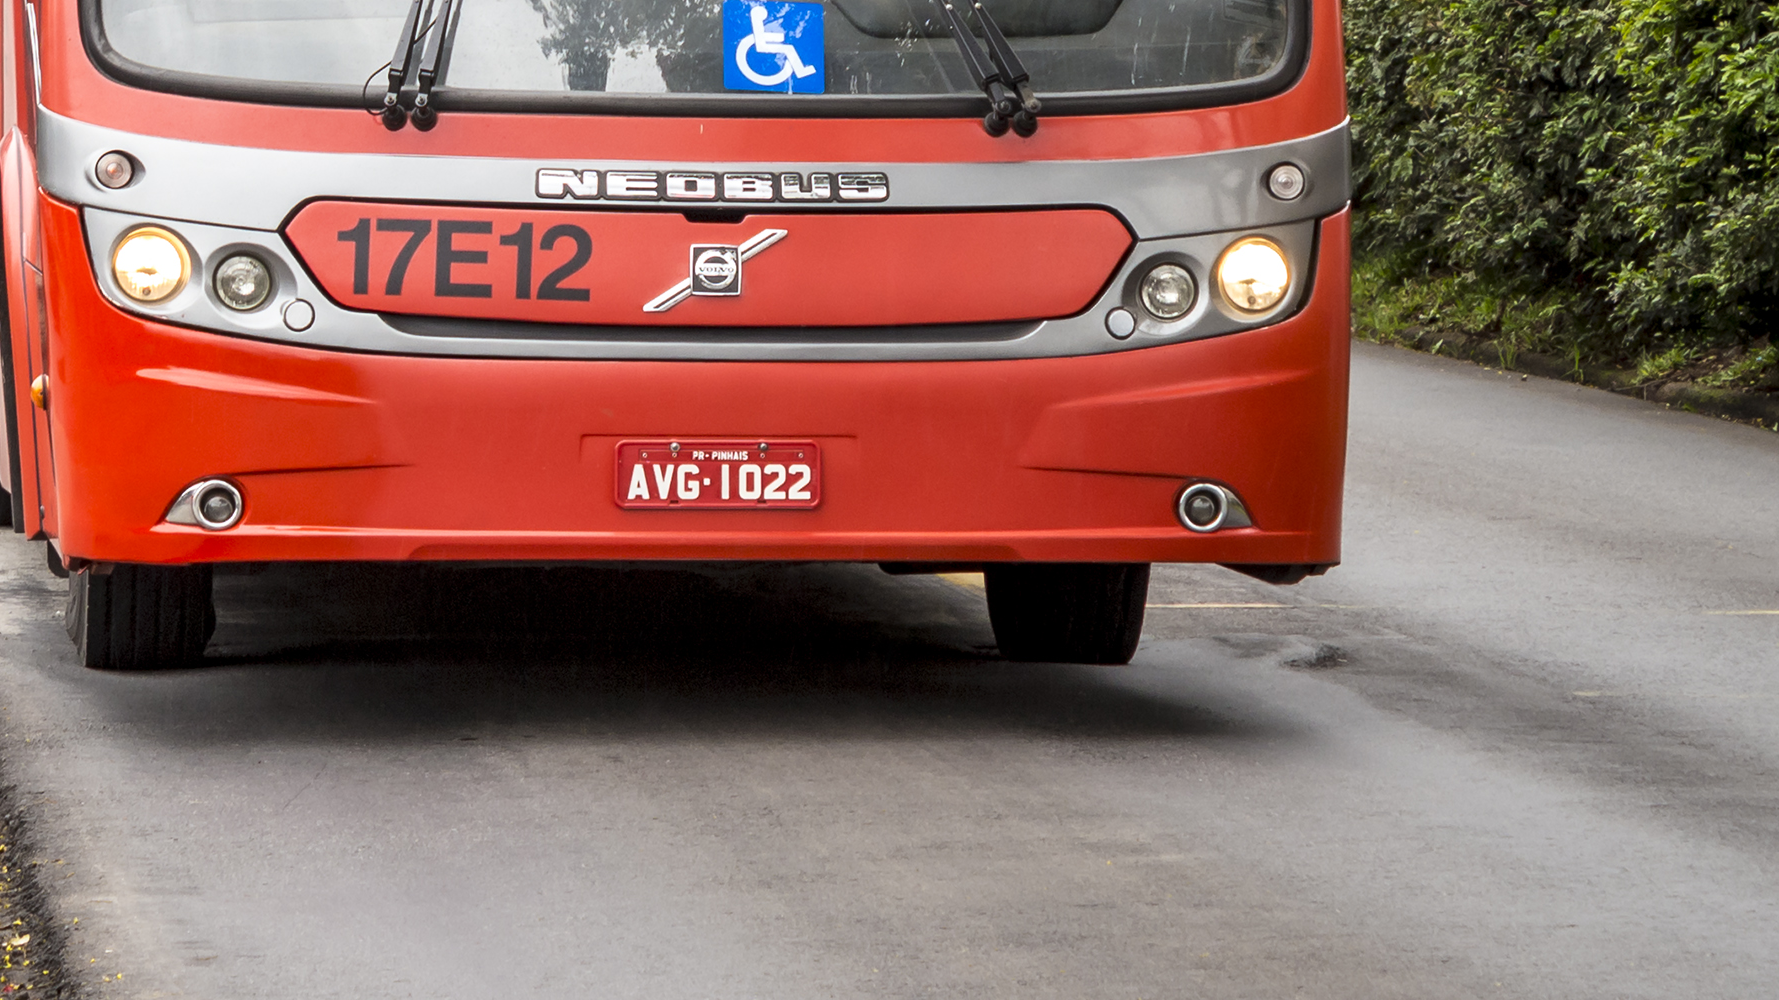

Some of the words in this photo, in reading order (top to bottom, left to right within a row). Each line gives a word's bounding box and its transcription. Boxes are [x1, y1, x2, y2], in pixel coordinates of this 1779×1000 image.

[536, 168, 889, 201] NEOBUS
[336, 217, 594, 302] 17E12
[698, 266, 735, 274] VOLVO
[711, 451, 749, 461] PINHAIS
